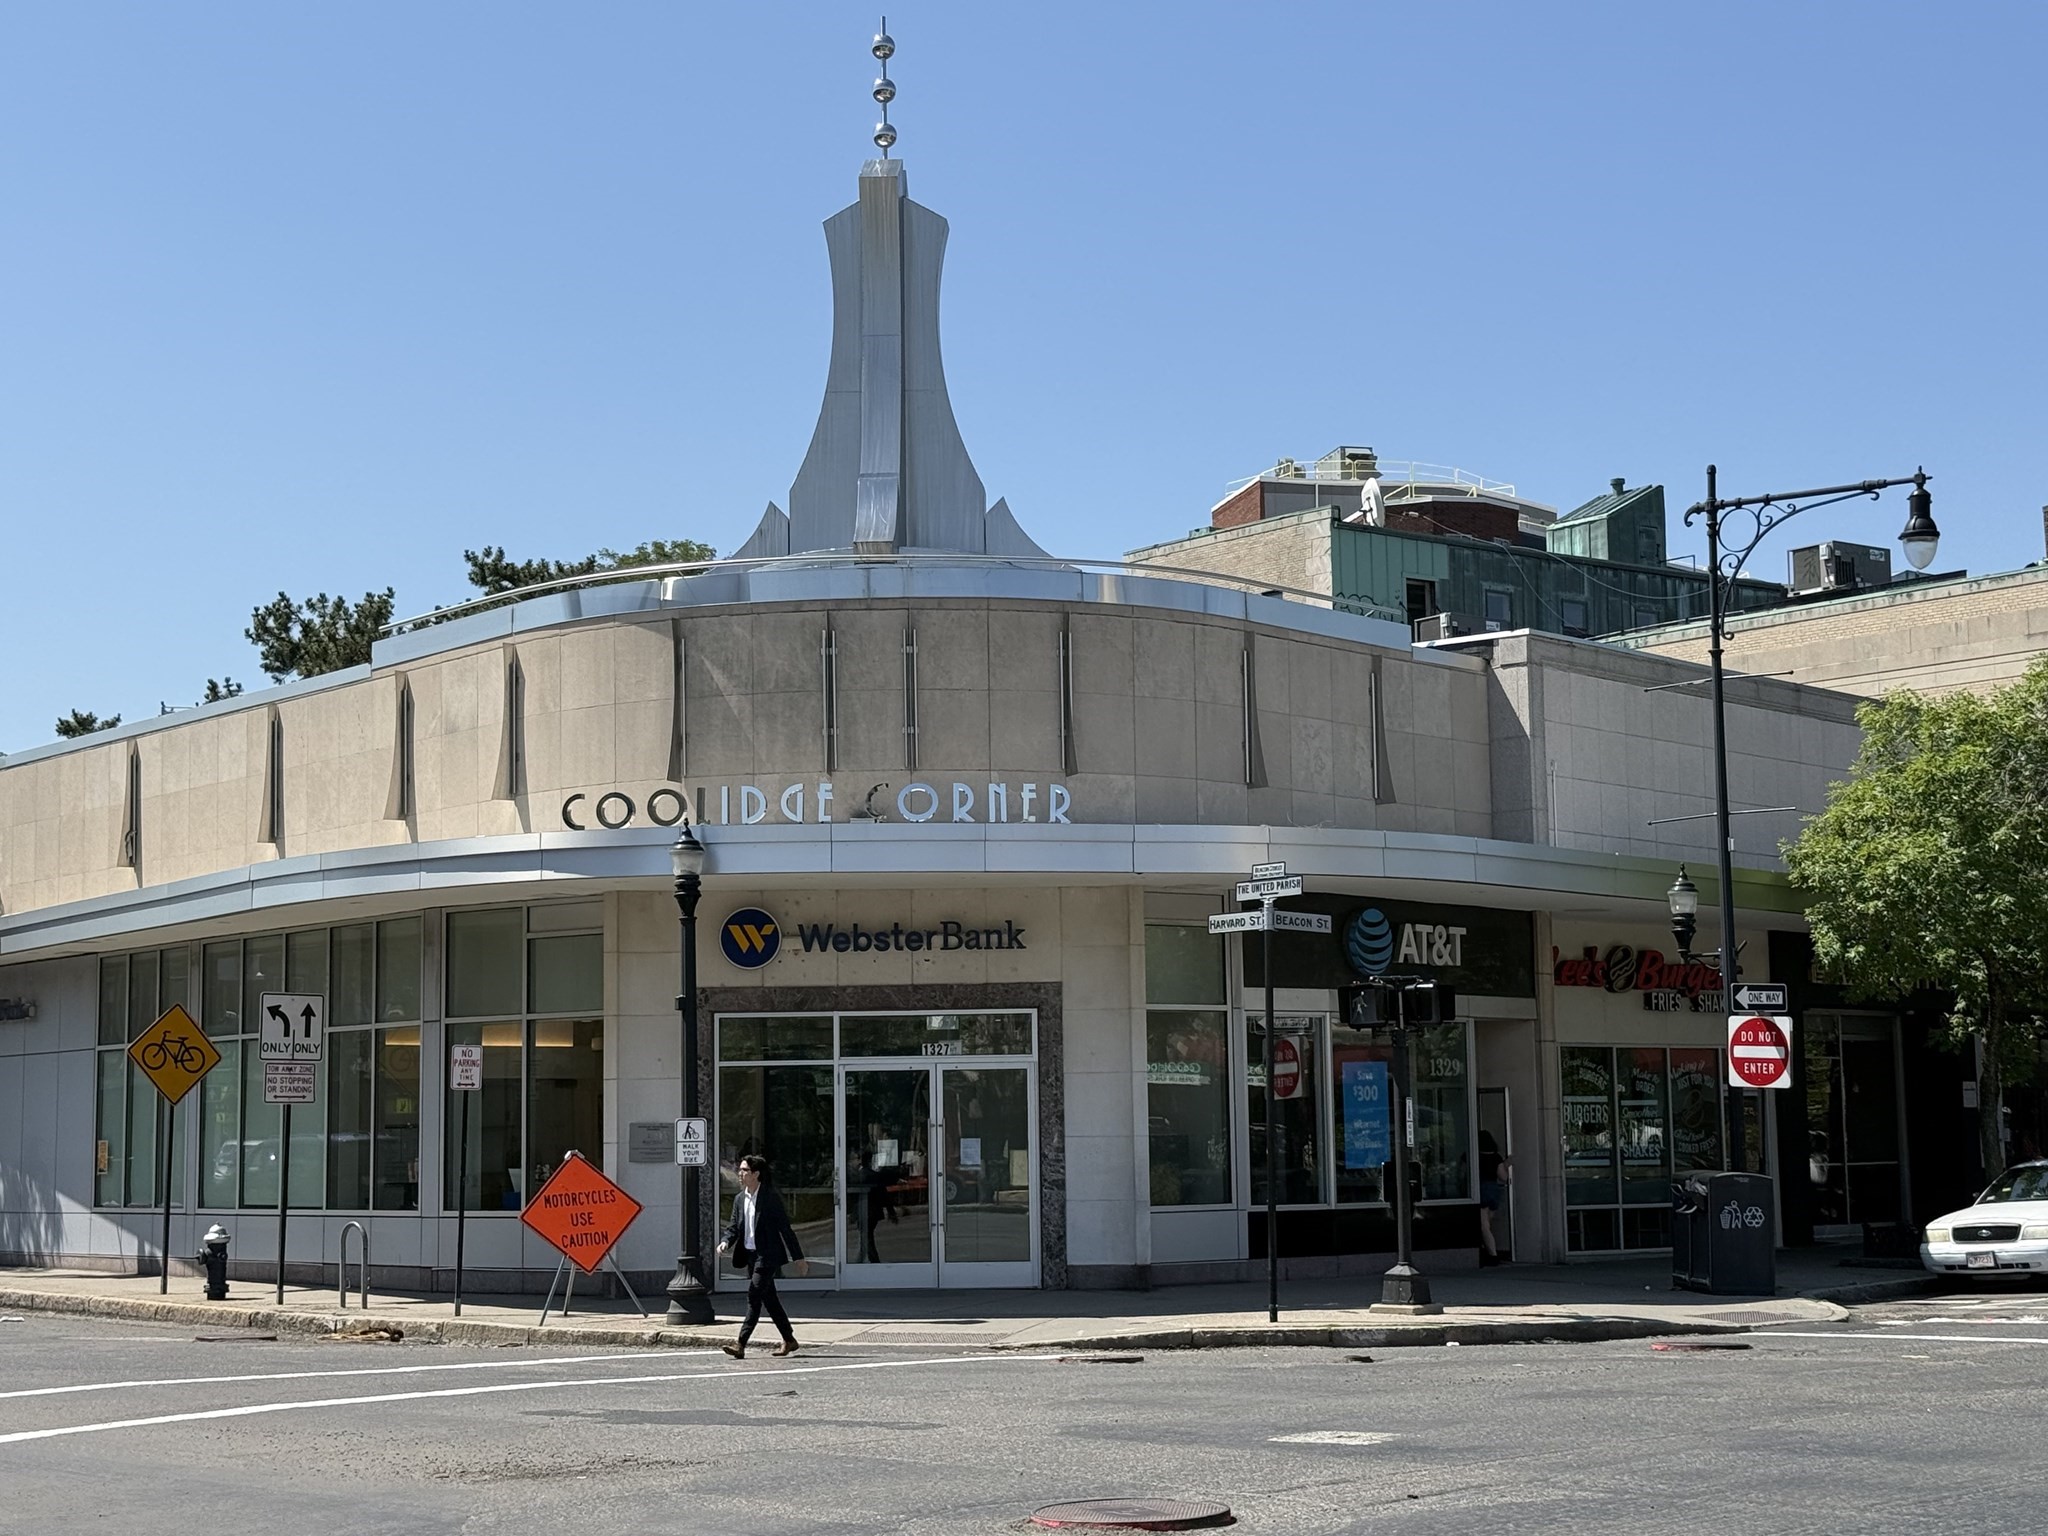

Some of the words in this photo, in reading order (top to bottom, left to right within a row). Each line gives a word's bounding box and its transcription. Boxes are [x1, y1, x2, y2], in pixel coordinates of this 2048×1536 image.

[562, 783, 834, 830] COOLIDGE
[864, 783, 1071, 824] CORNER
[1238, 884, 1249, 895] THE
[1251, 881, 1275, 893] UNITED
[1276, 879, 1301, 890] PARISH
[1209, 917, 1246, 930] HARVARD
[1275, 914, 1313, 928] BEACON
[1398, 923, 1467, 967] AT&T
[1652, 992, 1682, 1011] FRIES
[1698, 994, 1726, 1013] SHAK
[1748, 992, 1763, 1003] ONE
[1765, 992, 1781, 1003] WAY
[1741, 1031, 1754, 1042] DO
[1758, 1031, 1777, 1042] NOT
[262, 1042, 291, 1053] ONLY
[294, 1042, 321, 1054] ONLY
[461, 1049, 473, 1058] NO
[923, 1043, 950, 1056] 1327
[454, 1059, 480, 1068] PARKING
[1430, 1058, 1460, 1077] 1329
[1744, 1062, 1775, 1075] ENTER
[280, 1077, 312, 1085] STOPPING
[1579, 1067, 1608, 1091] BURGERS
[279, 1086, 312, 1094] STANDING
[1353, 1084, 1379, 1102] $300
[1563, 1104, 1609, 1124] BURGERS
[1623, 1144, 1661, 1158] SHAKES
[543, 1189, 617, 1209] MOTORCYCLES
[570, 1212, 595, 1227] USE
[561, 1231, 609, 1249] CAUTION
